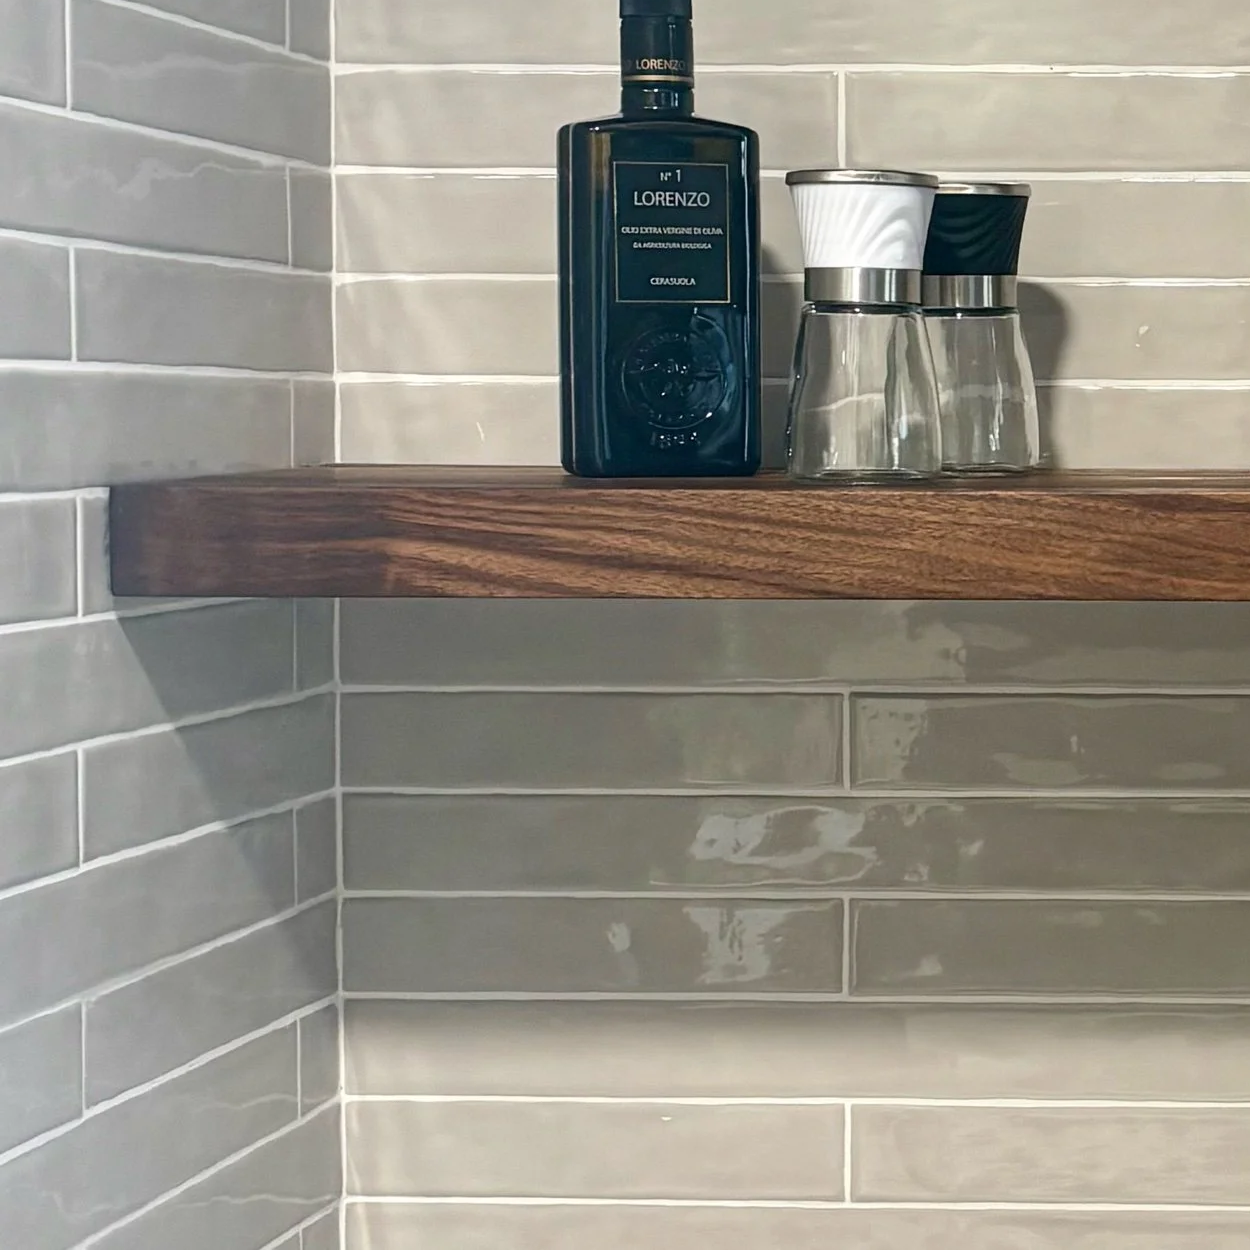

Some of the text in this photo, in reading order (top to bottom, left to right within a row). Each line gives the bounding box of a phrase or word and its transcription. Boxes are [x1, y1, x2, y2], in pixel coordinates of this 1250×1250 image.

[635, 58, 686, 71] LORENZO
[675, 169, 681, 183] 1
[634, 191, 710, 207] LORENZO
[640, 226, 662, 235] EXTRA
[650, 277, 696, 286] CERASUOLA
